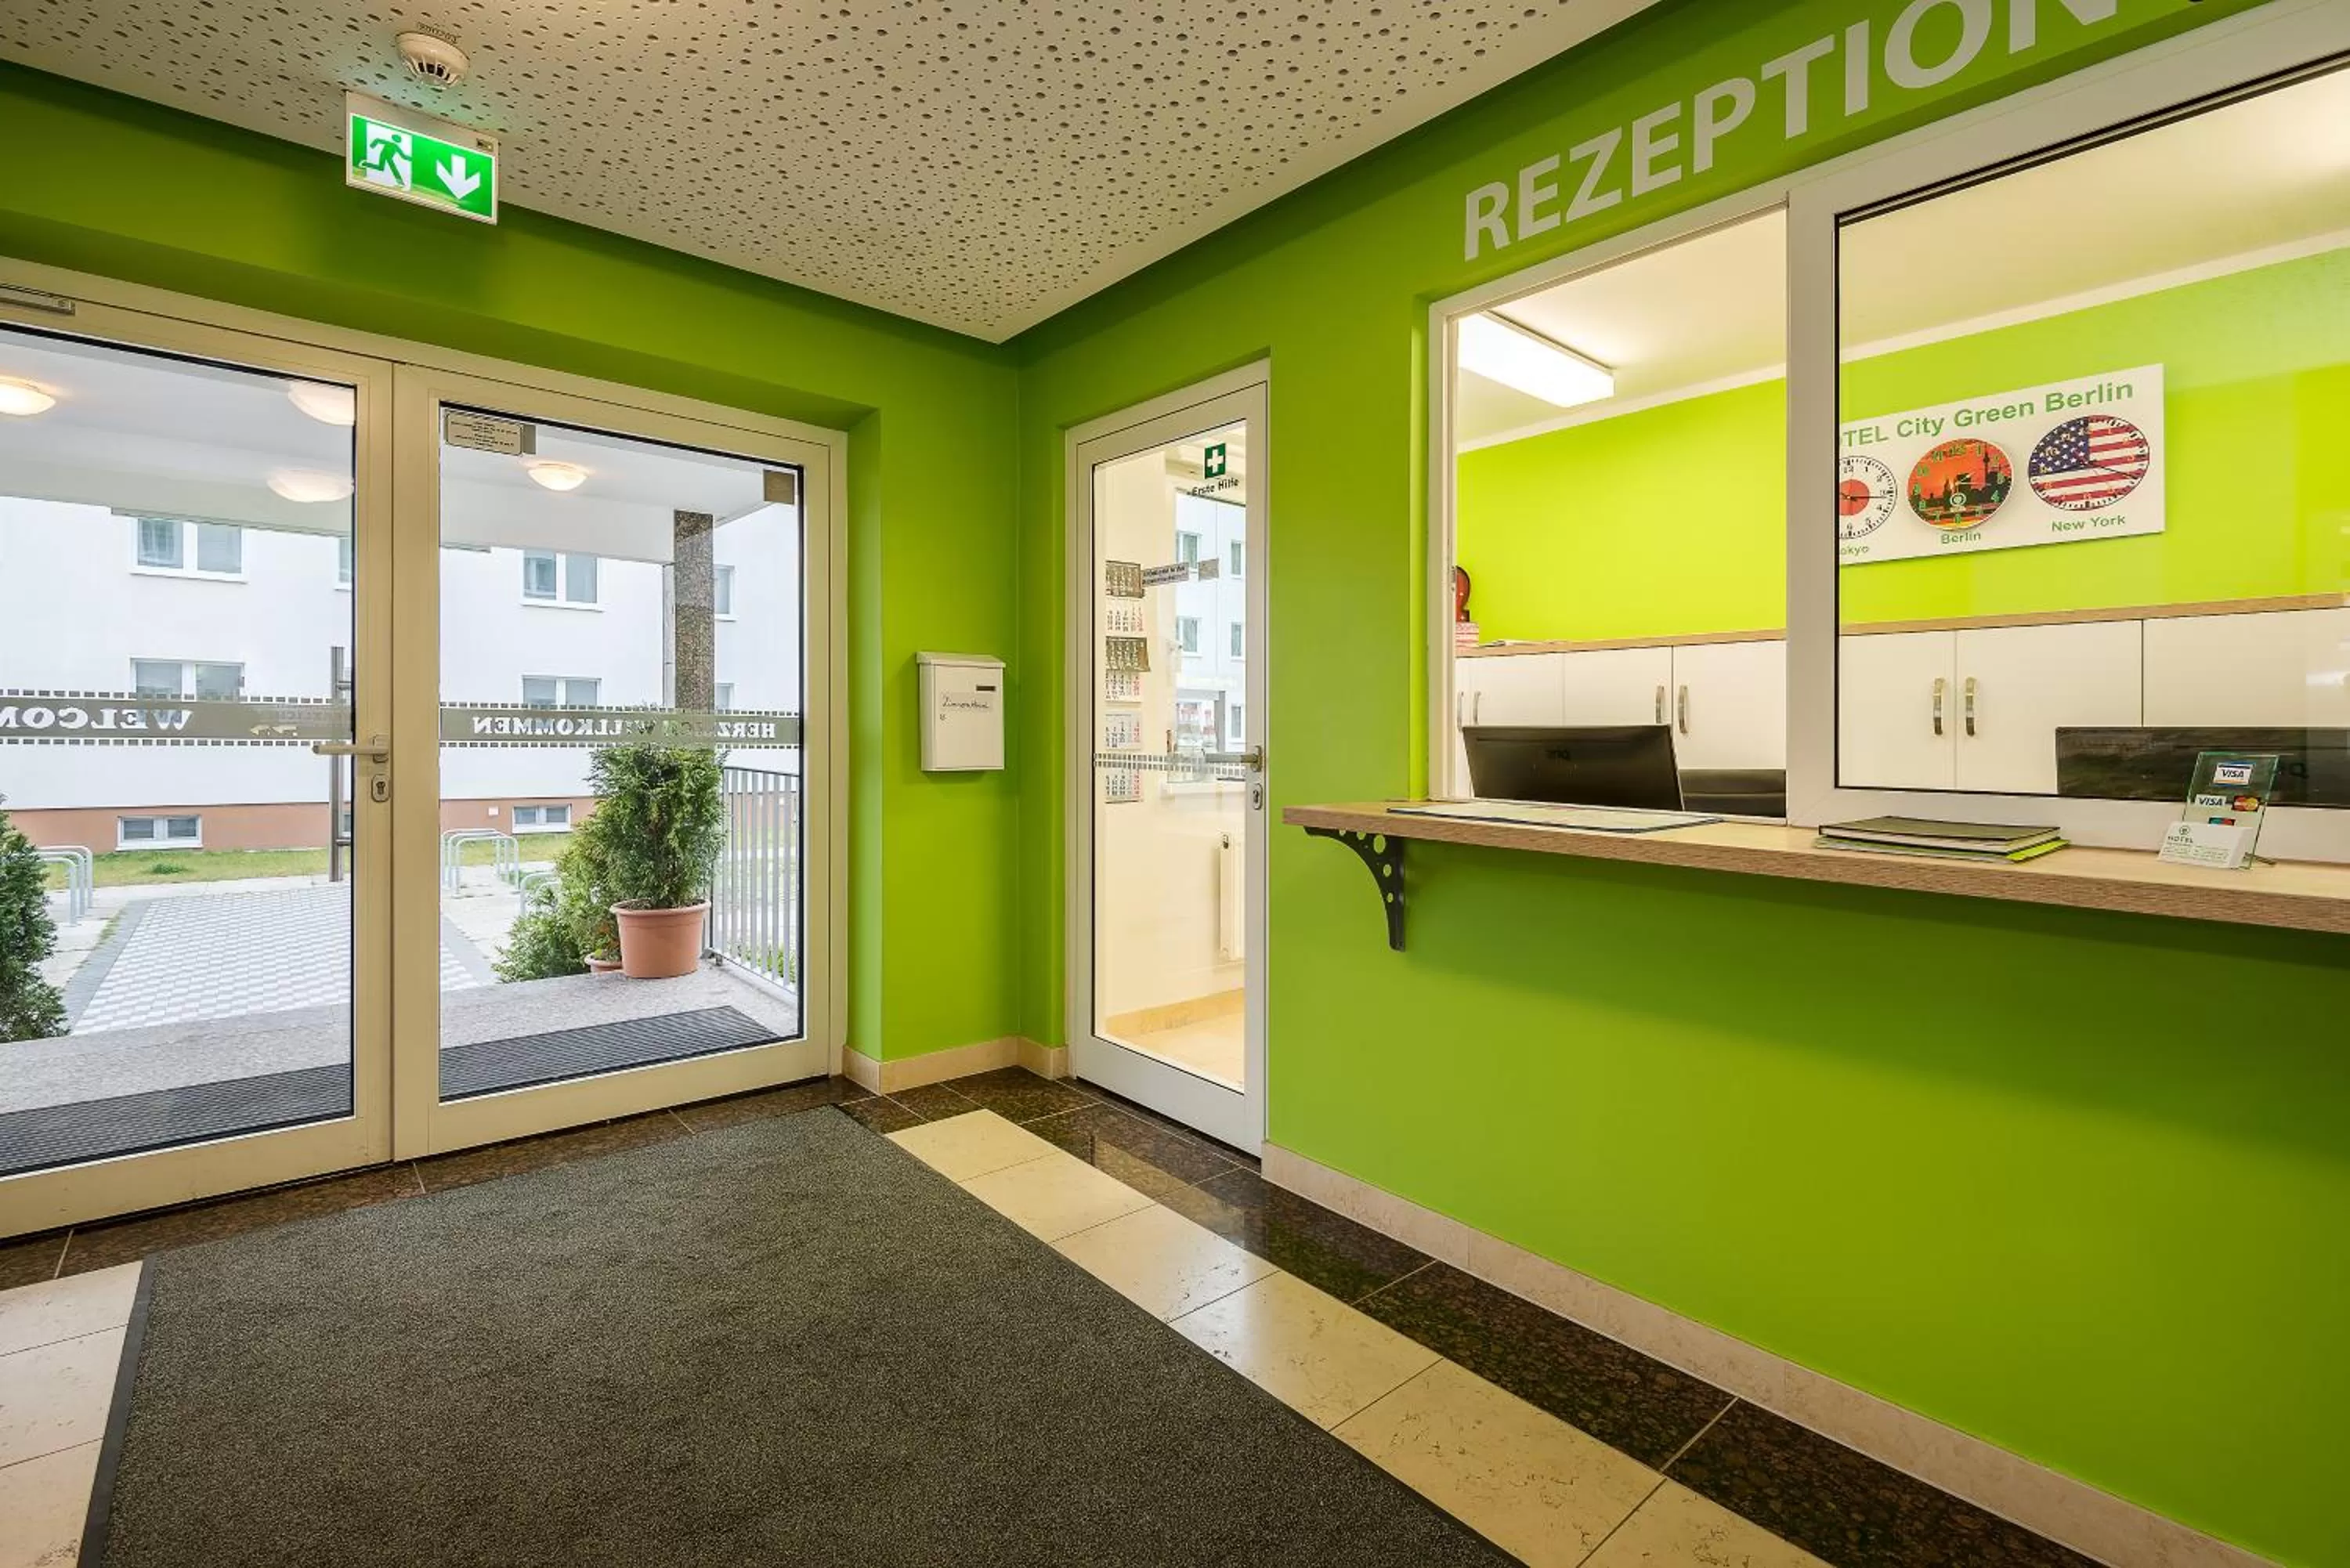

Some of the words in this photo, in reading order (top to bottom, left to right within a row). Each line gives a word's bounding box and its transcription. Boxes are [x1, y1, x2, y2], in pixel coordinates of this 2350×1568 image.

[1840, 425, 1888, 447] TEL
[1896, 417, 1945, 437] City
[1954, 400, 2034, 428] Green
[2044, 382, 2134, 414] Berlin
[1191, 484, 1215, 496] Erste
[1218, 478, 1240, 490] Hilfe
[2052, 520, 2085, 532] New
[2090, 515, 2126, 527] York
[1941, 532, 1981, 544] Berlin
[1840, 546, 1870, 556] okyo
[2222, 769, 2244, 778] VISA
[2199, 797, 2222, 806] VISA
[2167, 835, 2194, 844] HOTEL
